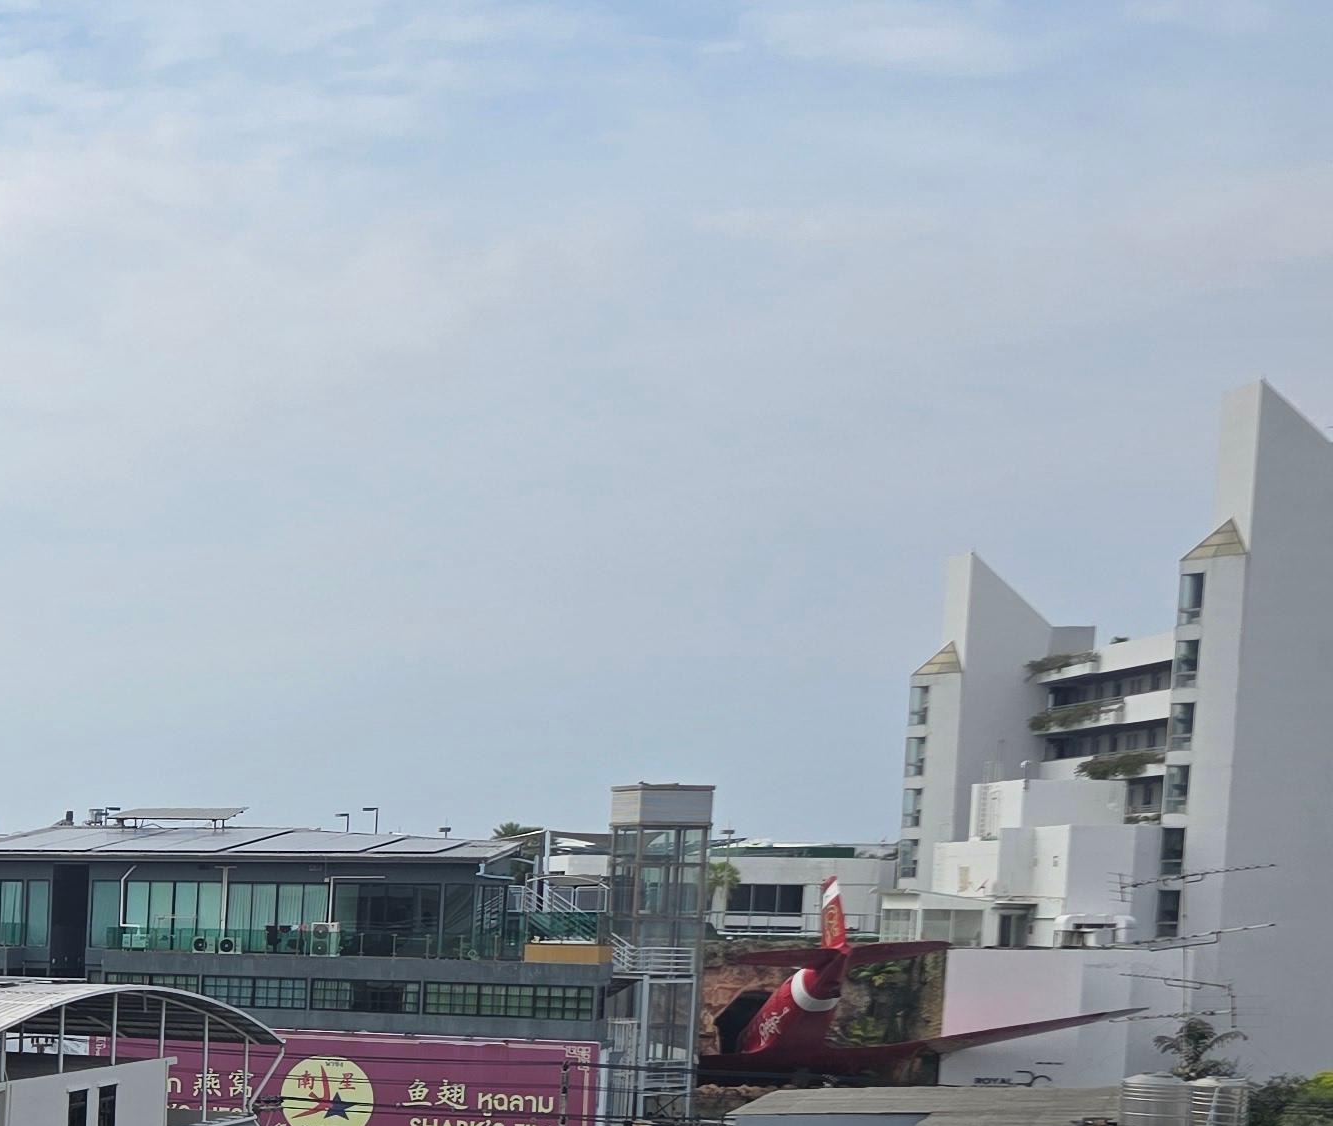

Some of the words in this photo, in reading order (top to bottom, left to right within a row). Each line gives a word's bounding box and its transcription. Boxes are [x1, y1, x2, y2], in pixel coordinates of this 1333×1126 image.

[402, 1079, 469, 1110] 鱼翅
[477, 1092, 554, 1116] หูฉลาม
